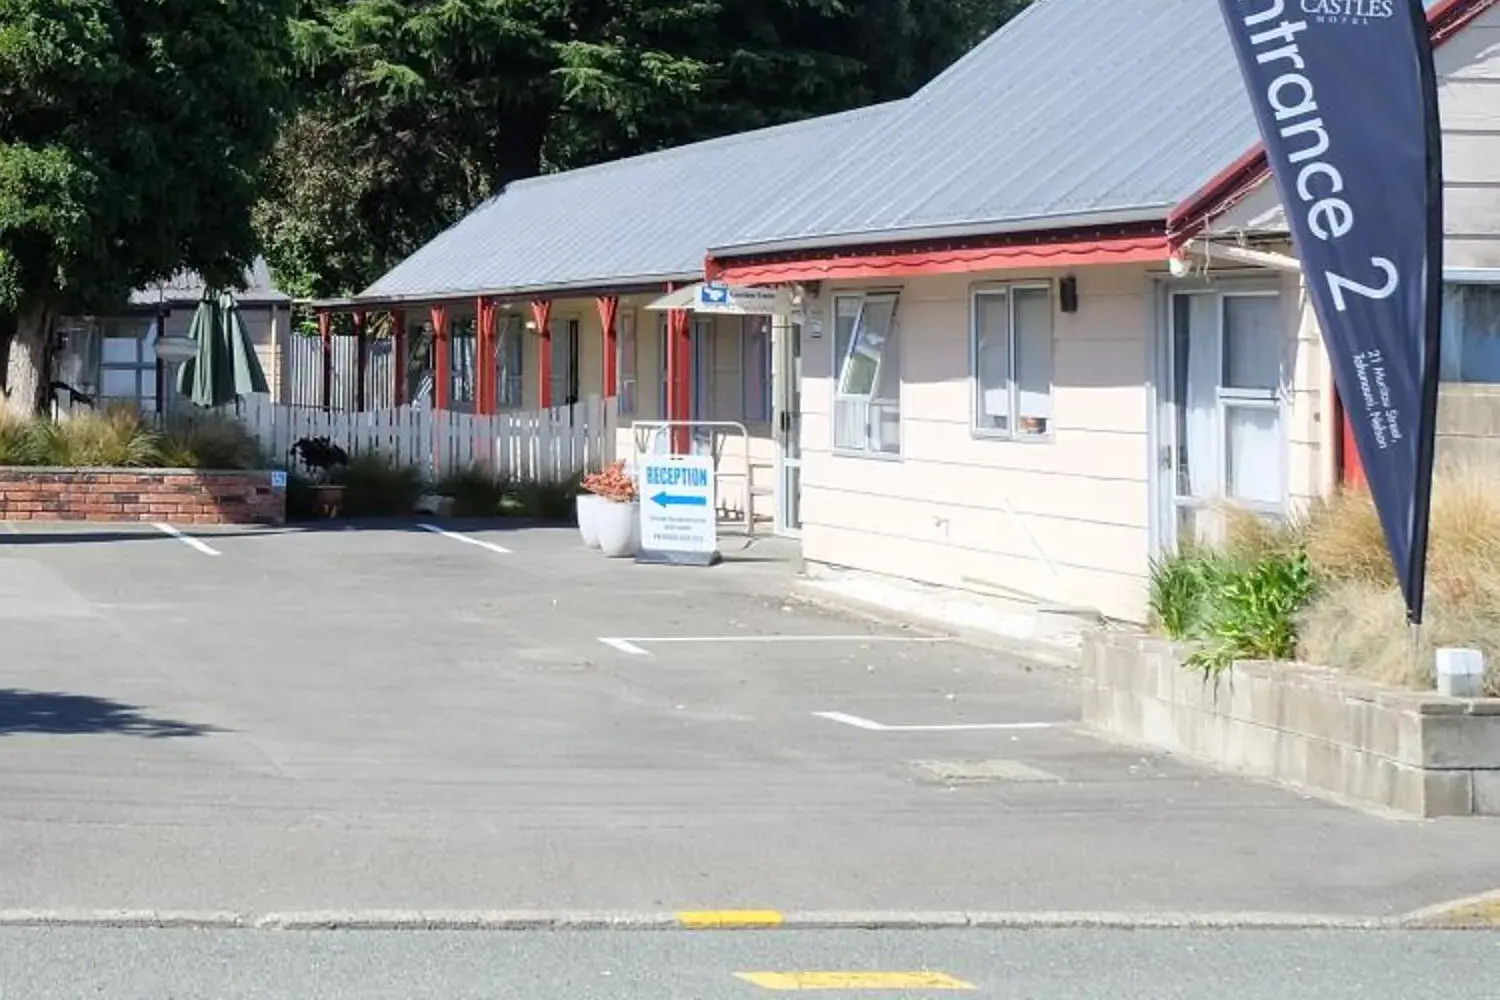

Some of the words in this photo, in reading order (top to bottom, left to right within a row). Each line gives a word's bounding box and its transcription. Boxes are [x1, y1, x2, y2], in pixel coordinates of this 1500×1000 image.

[1324, 257, 1399, 312] 2
[1367, 349, 1382, 363] 21
[646, 466, 708, 487] RECEPTION
